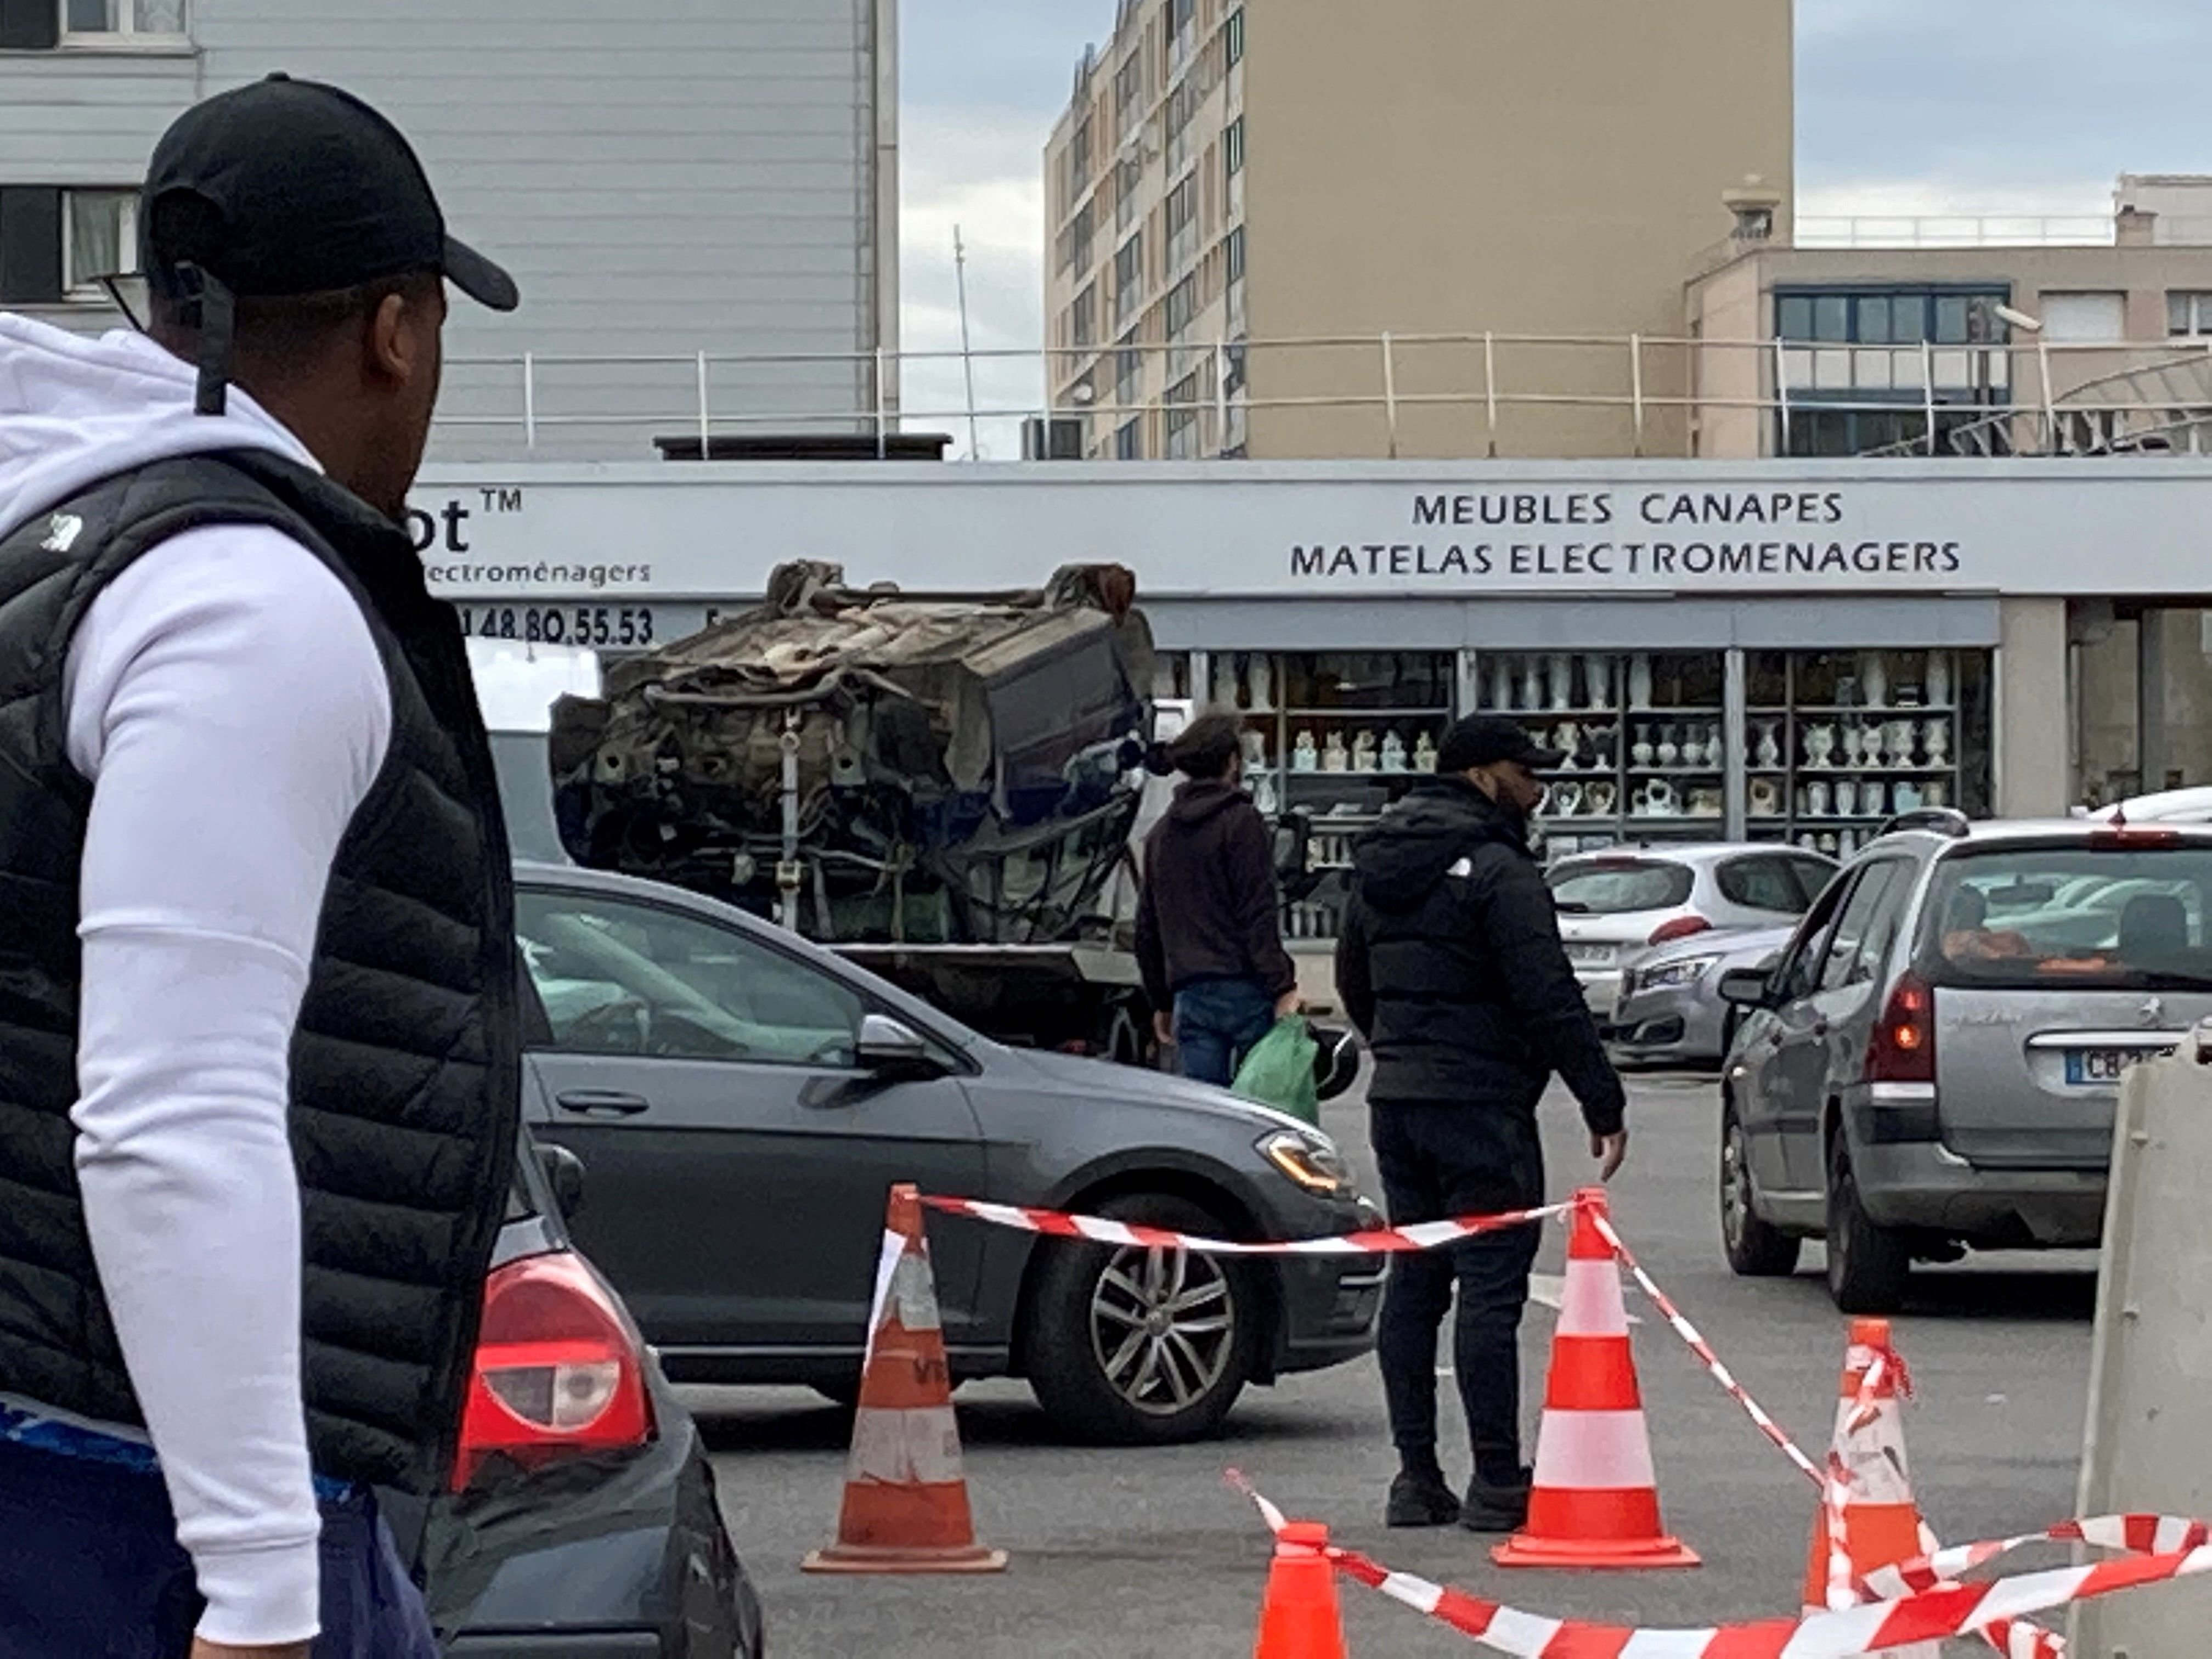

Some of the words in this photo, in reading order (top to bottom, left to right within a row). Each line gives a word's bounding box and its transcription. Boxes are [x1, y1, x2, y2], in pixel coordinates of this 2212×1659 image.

[1412, 493, 1612, 525] MEUBLES
[1640, 492, 1842, 524] CANAPES
[427, 561, 650, 588] ectroménagers
[1290, 544, 1493, 577] MATELAS
[1510, 542, 1960, 574] ELECTROMENAGERS
